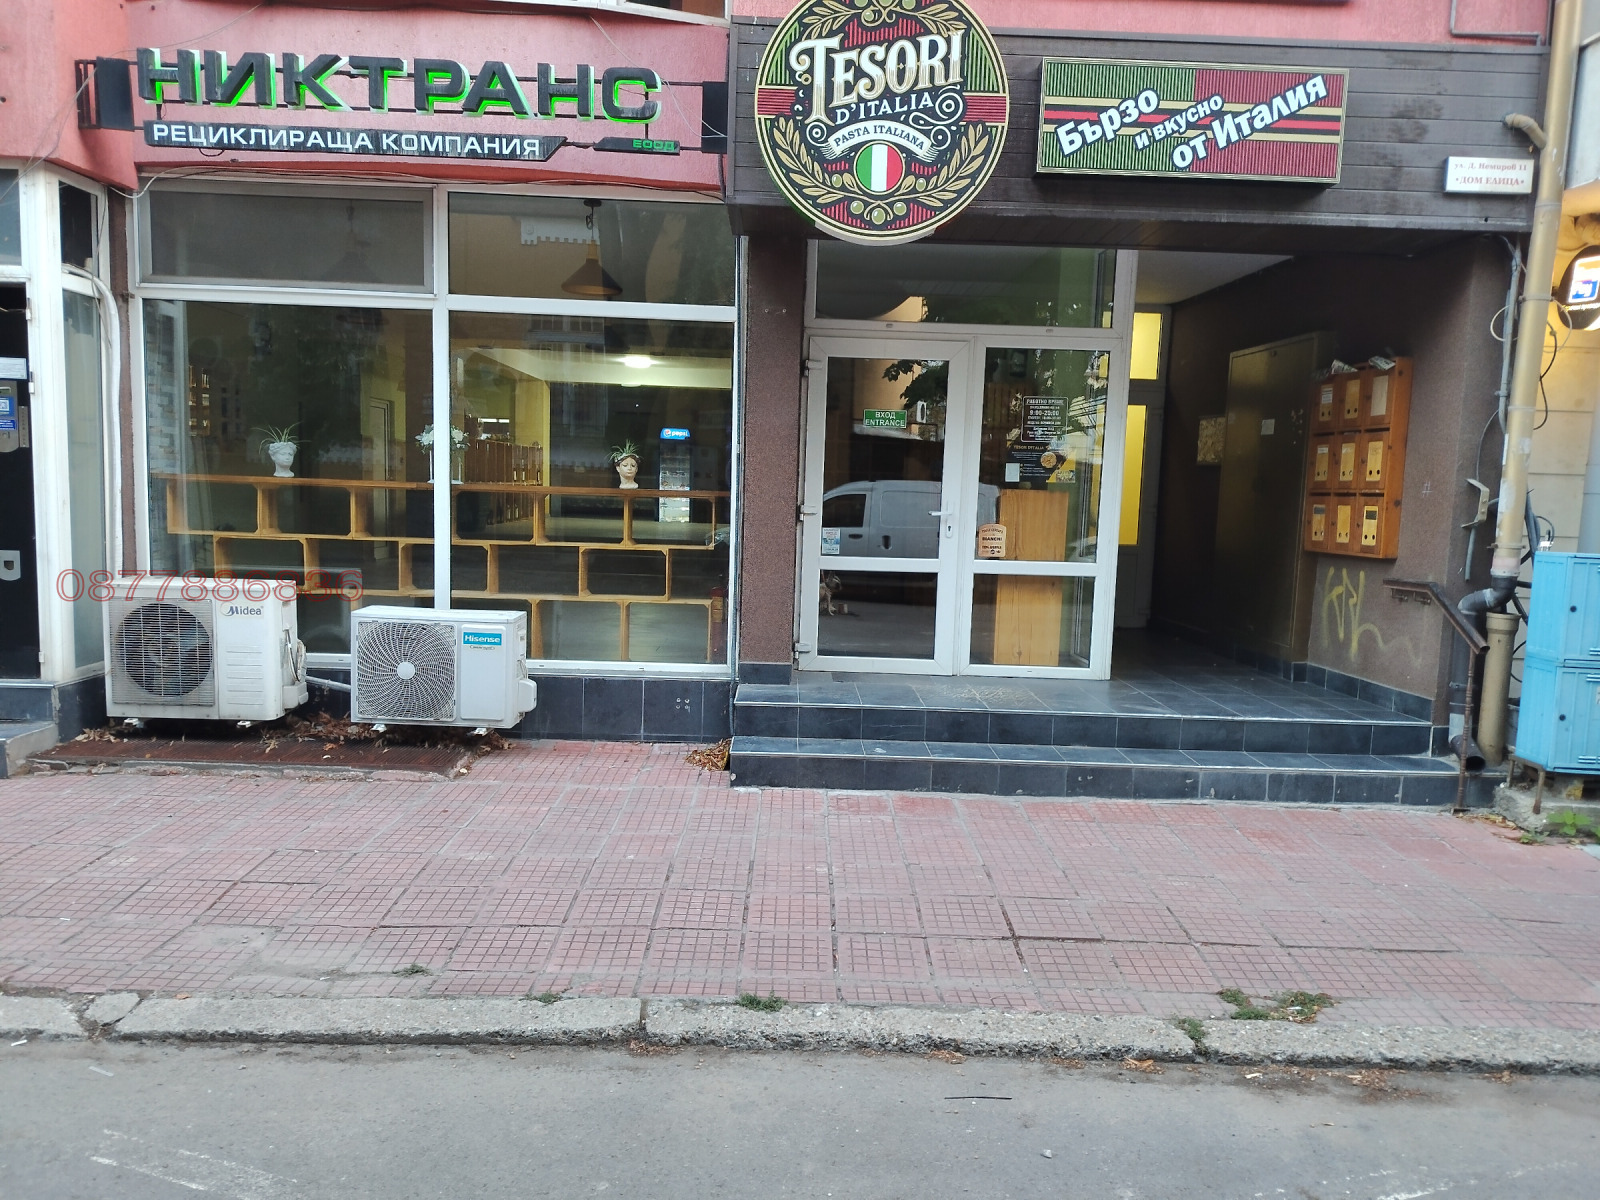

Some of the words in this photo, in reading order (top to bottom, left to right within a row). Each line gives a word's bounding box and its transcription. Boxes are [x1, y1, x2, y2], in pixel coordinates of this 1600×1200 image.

[137, 47, 662, 122] НИКТРАНС
[789, 30, 966, 126] TESORI
[835, 92, 934, 125] D'ITALIA
[1057, 89, 1159, 156] Бързо
[1134, 131, 1149, 150] и
[1153, 95, 1223, 141] вкусно
[1172, 132, 1208, 169] от
[1211, 75, 1328, 150] Италия
[153, 124, 373, 152] РЕЦИКЛИРАЩА
[382, 133, 540, 156] КОМПАНИЯ
[632, 139, 676, 151] ЕООД
[833, 126, 871, 148] PASTA
[873, 124, 925, 151] ITALIANA
[865, 419, 905, 427] ENTRANCE
[875, 411, 896, 419] ВХОД
[226, 605, 262, 616] Midea
[464, 634, 501, 643] Hisense
